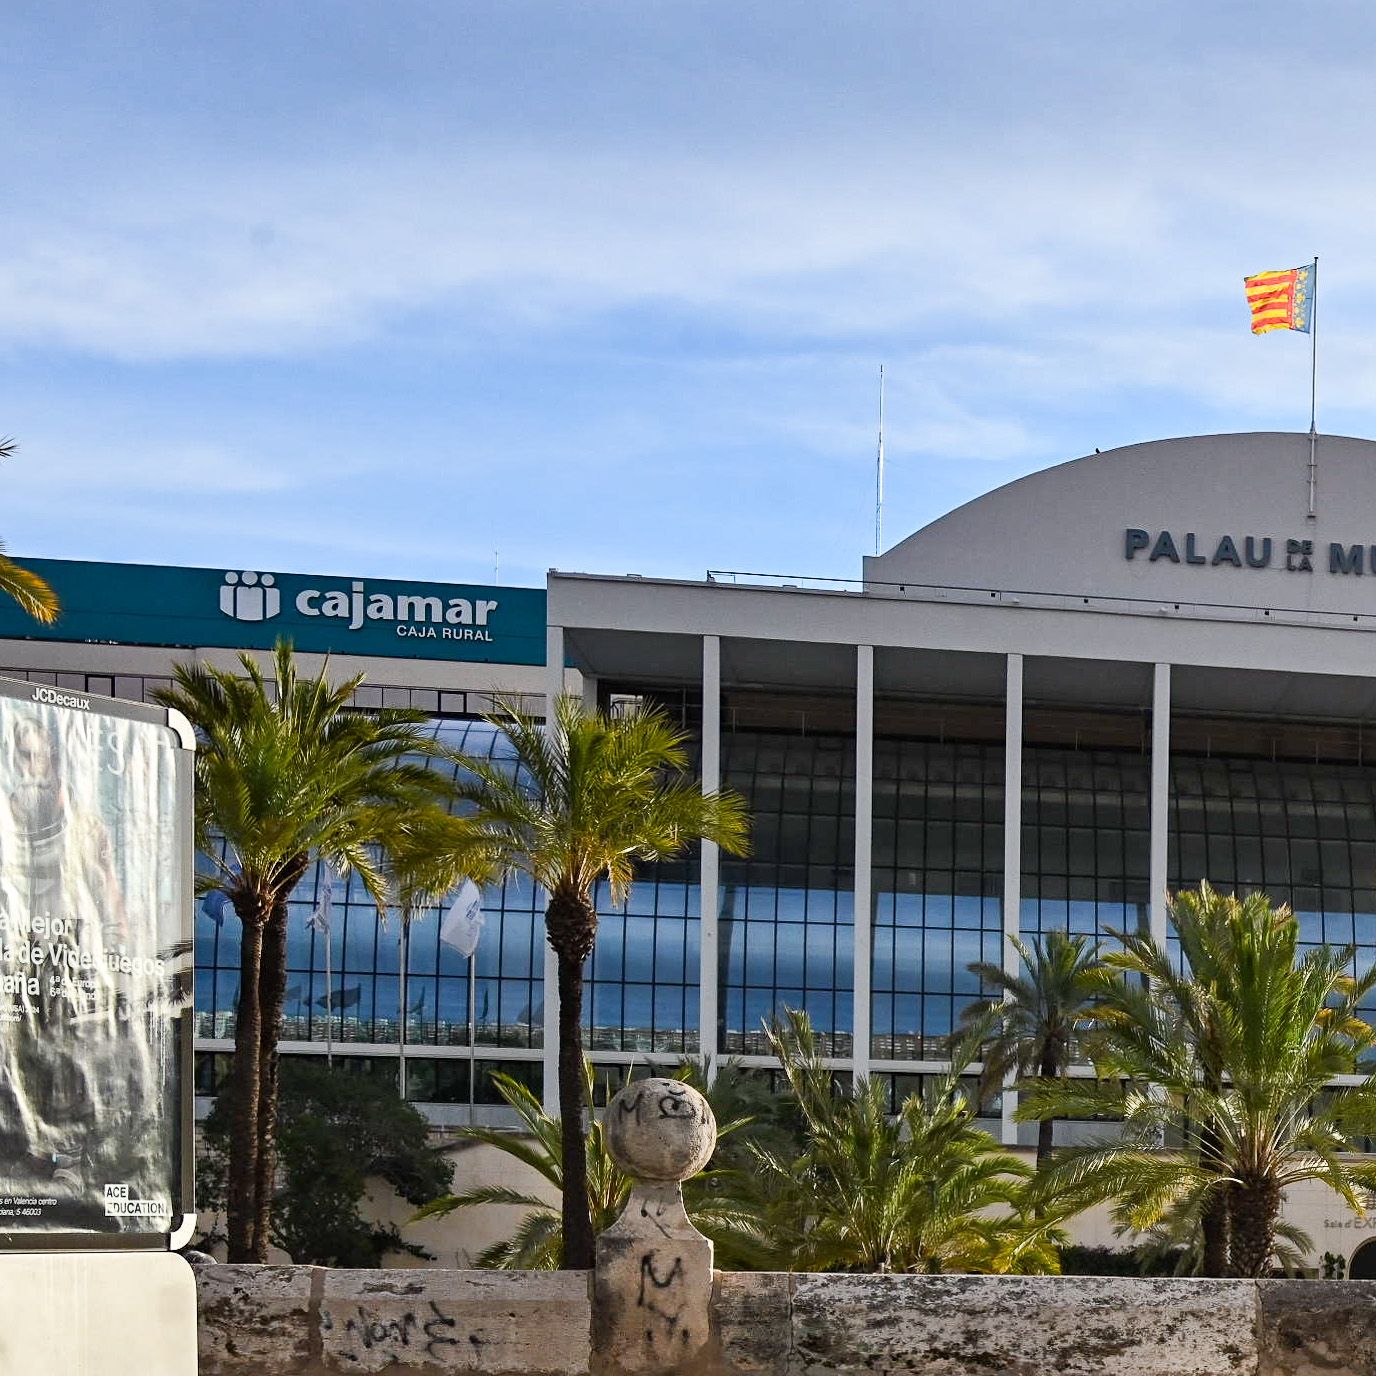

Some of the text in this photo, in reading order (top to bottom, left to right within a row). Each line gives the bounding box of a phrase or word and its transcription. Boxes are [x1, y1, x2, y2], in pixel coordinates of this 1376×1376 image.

[1125, 528, 1272, 568] PALAU
[1286, 538, 1313, 555] DE
[1286, 555, 1314, 572] LA
[295, 581, 498, 630] cajamar
[396, 625, 494, 642] CAJA RURAL
[31, 687, 91, 711] JCDecaux
[48, 942, 166, 978] Videuegos
[106, 1186, 127, 1198] ACE
